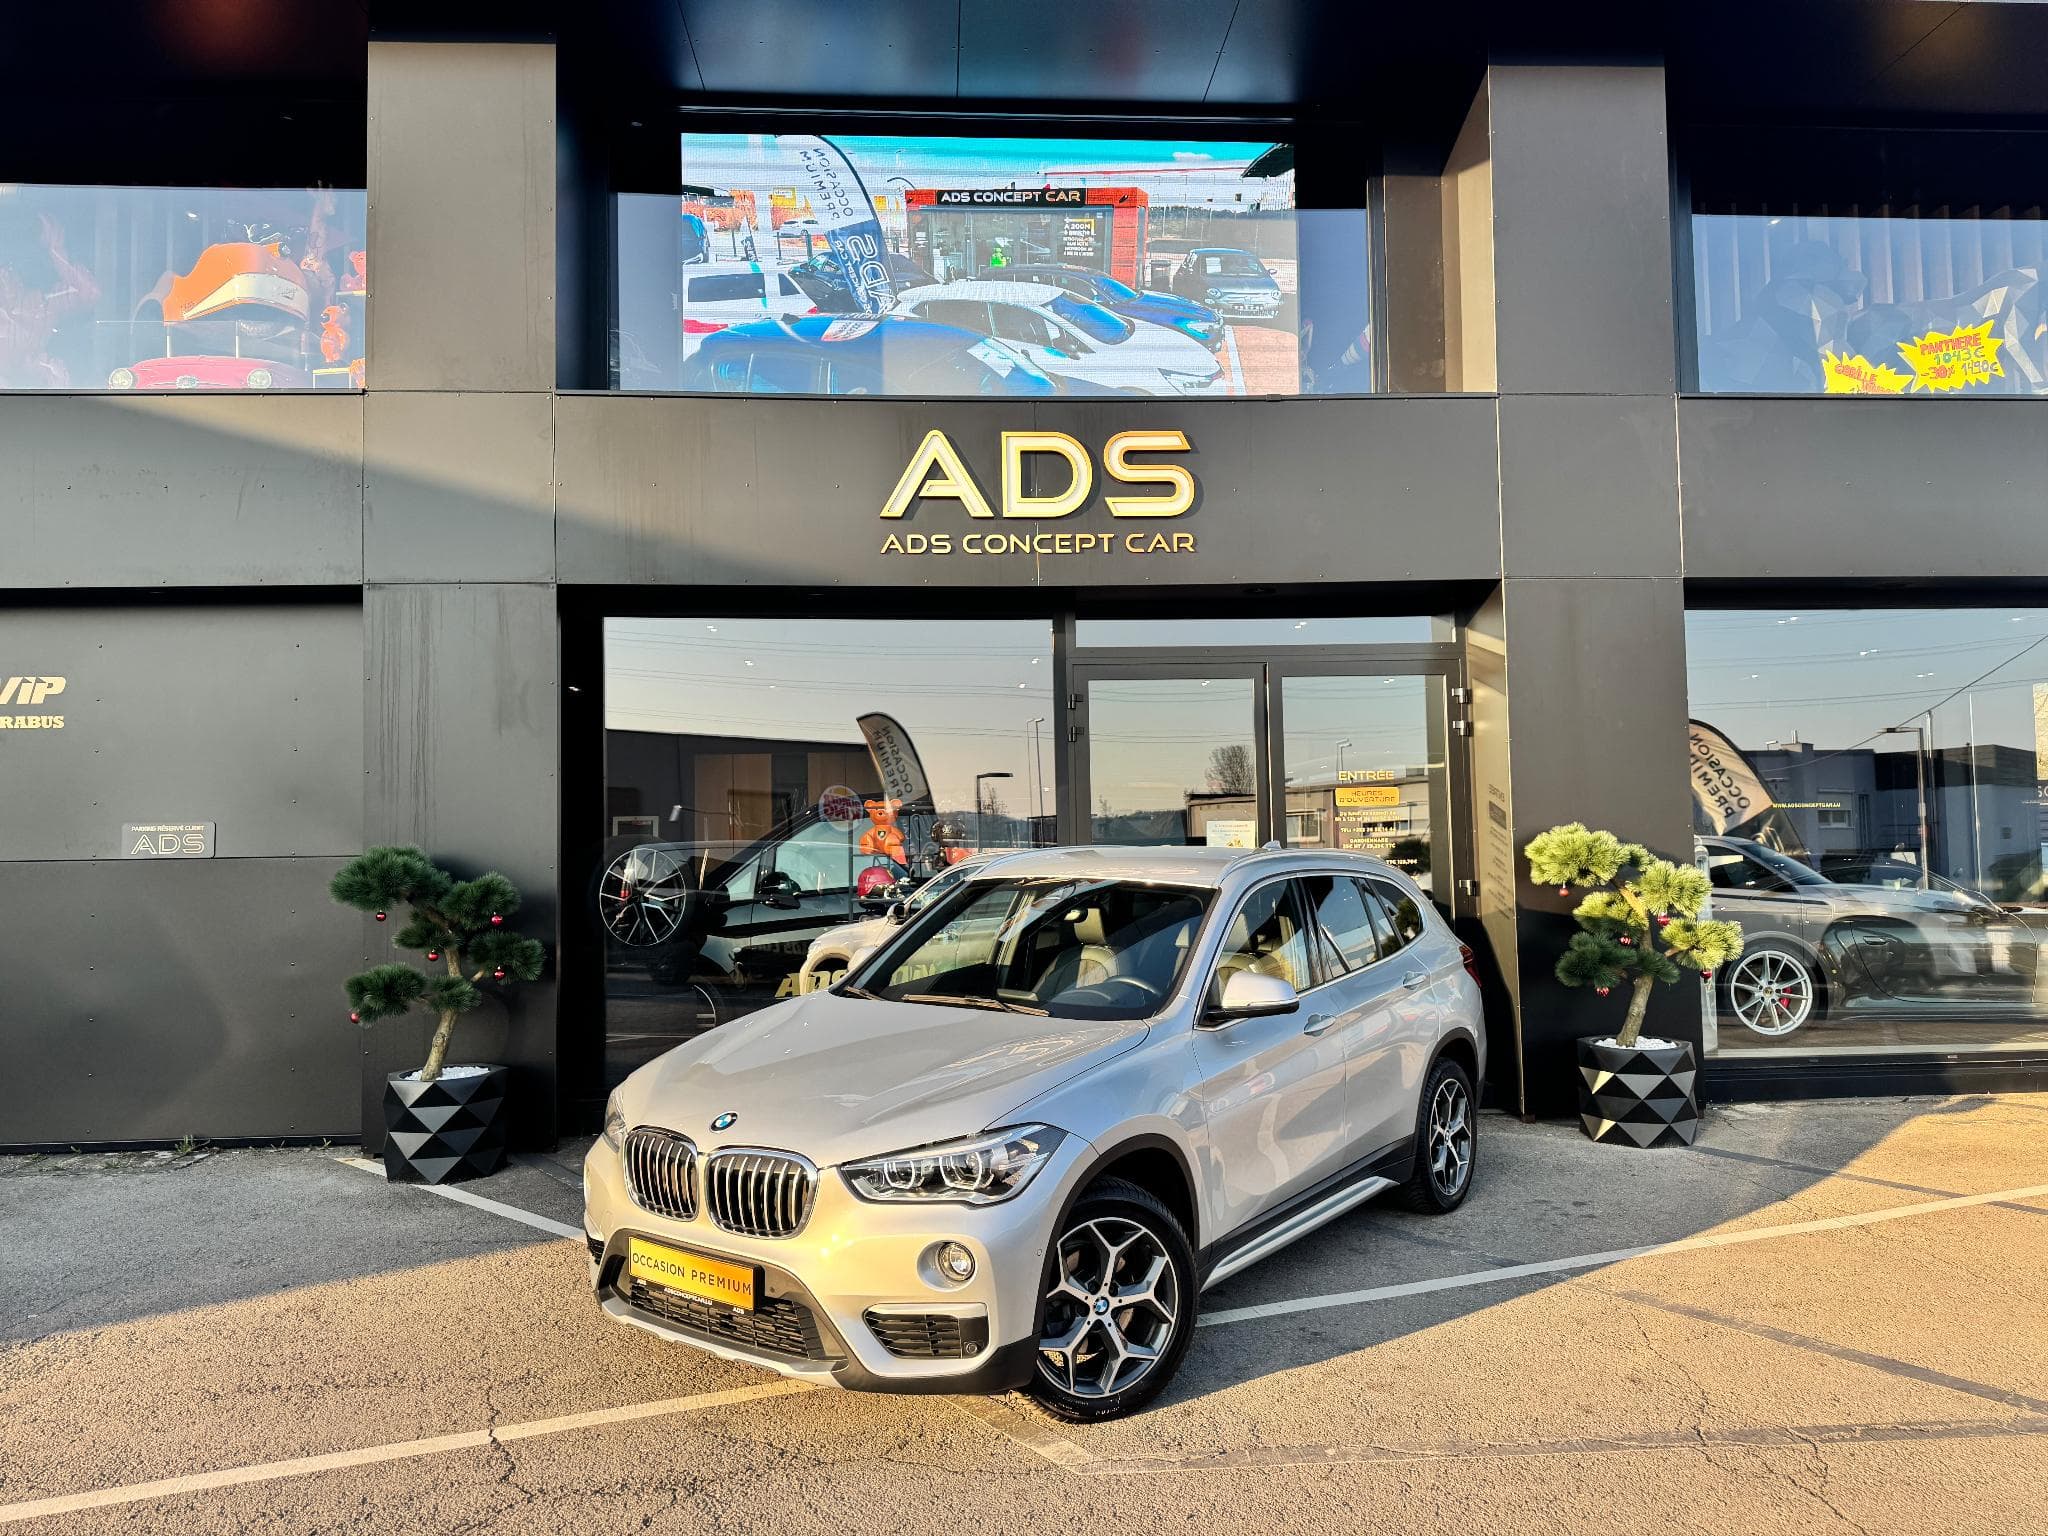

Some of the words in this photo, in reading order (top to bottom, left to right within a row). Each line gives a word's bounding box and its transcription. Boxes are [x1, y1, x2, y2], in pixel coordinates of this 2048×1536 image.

[941, 192, 971, 203] ADS
[973, 191, 1041, 203] CONCEPT
[1045, 190, 1081, 202] CAR
[1920, 333, 1981, 356] PANTHERE
[880, 430, 1195, 518] ADS
[881, 533, 951, 554] ADS
[962, 533, 1114, 554] CONCEPT
[1125, 533, 1195, 553] CAR
[0, 715, 65, 729] RABUS
[1338, 769, 1394, 780] ENTRÉE
[131, 834, 205, 854] ADS
[632, 1252, 685, 1277] OCCASION
[691, 1269, 752, 1296] PREMIUM
